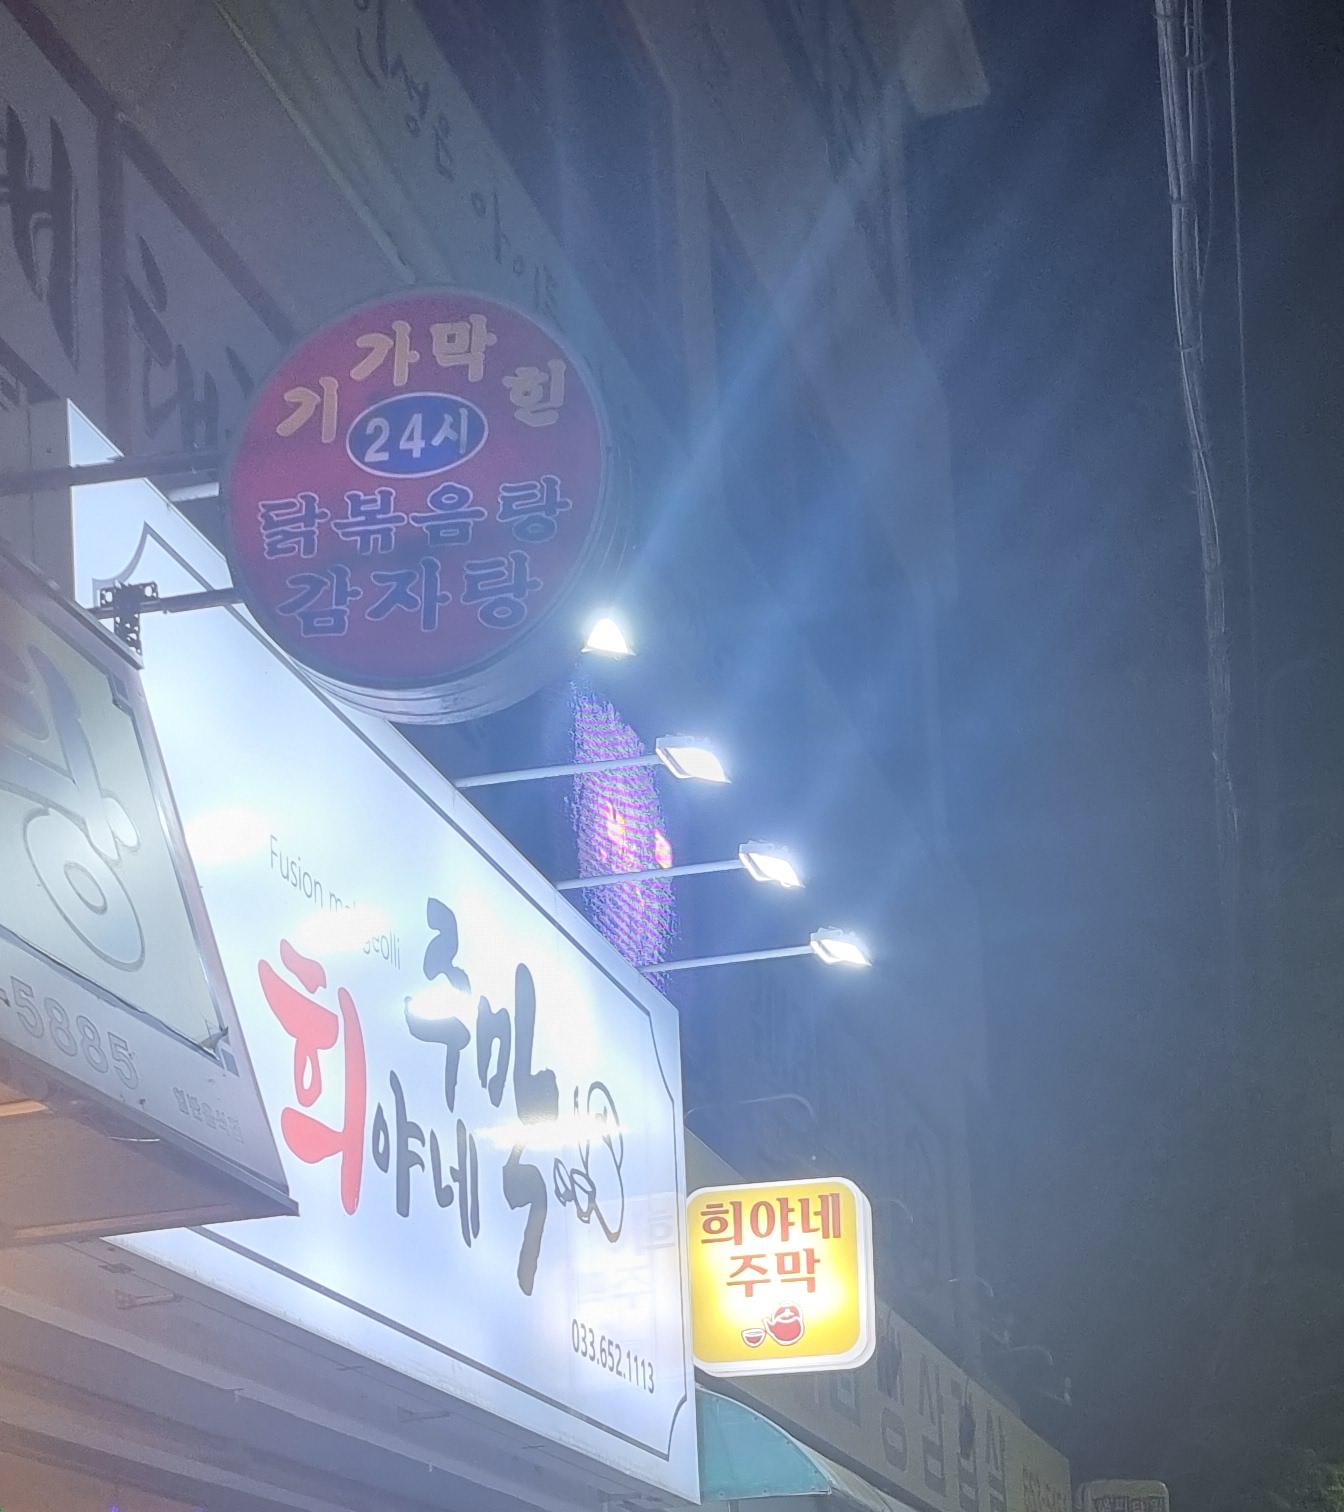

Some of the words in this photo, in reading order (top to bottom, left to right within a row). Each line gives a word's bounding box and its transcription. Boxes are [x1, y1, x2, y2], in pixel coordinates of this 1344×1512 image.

[276, 314, 565, 446] 기가막힌
[364, 409, 471, 465] 24시
[258, 475, 572, 560] 닭볶음탕
[286, 551, 543, 638] 감자탕
[268, 832, 323, 908] Fusion
[328, 889, 401, 969] meolli
[258, 938, 480, 1248] 희야네
[699, 1191, 842, 1246] 희야네
[725, 1246, 821, 1298] 주막
[570, 1317, 656, 1395] 033.652.1113
